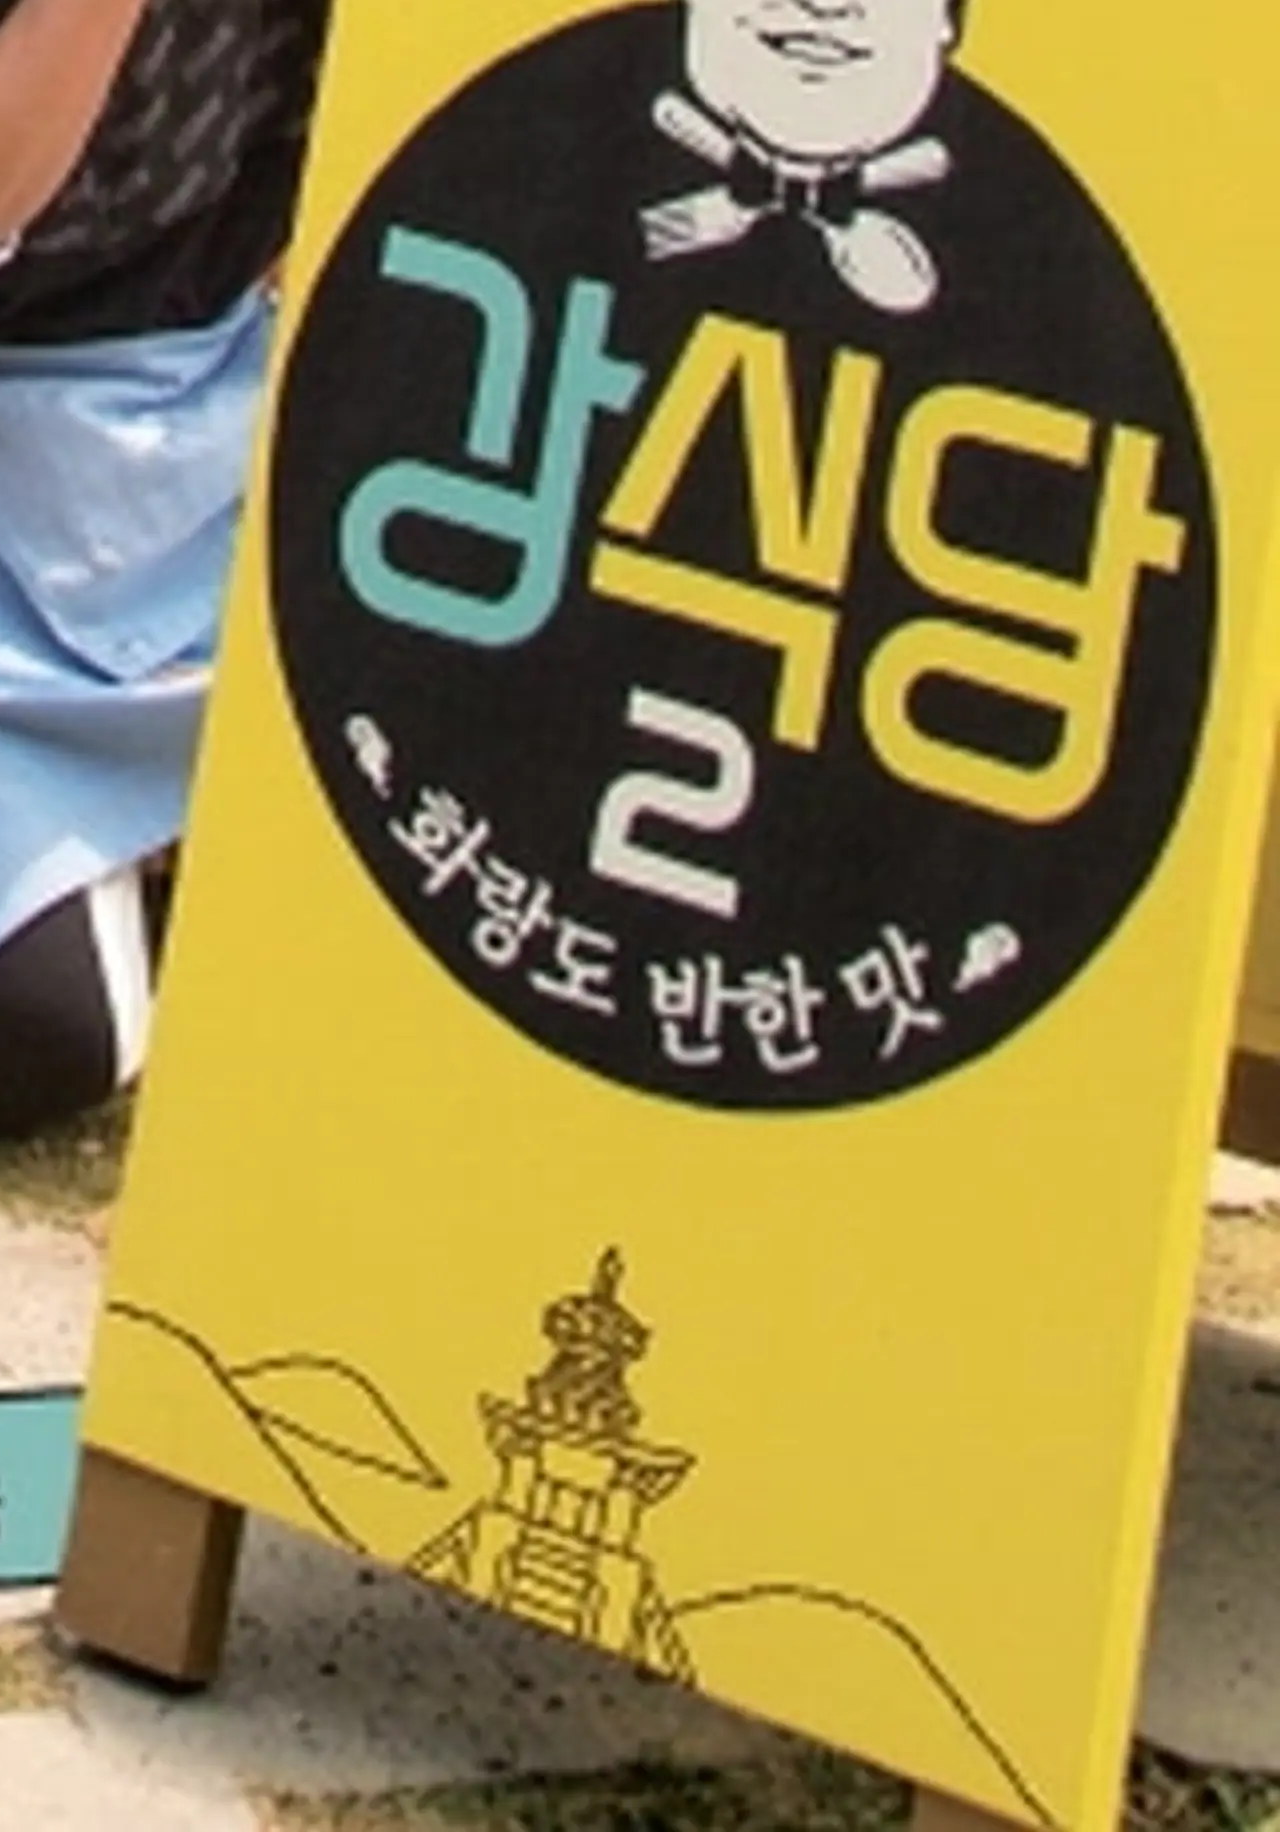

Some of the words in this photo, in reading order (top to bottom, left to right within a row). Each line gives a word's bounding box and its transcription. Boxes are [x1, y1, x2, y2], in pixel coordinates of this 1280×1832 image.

[338, 223, 1186, 826] 강식당
[388, 788, 621, 1016] 화랑도
[647, 953, 827, 1074] 반한
[839, 923, 944, 1059] 맛
[589, 687, 756, 920] 2
